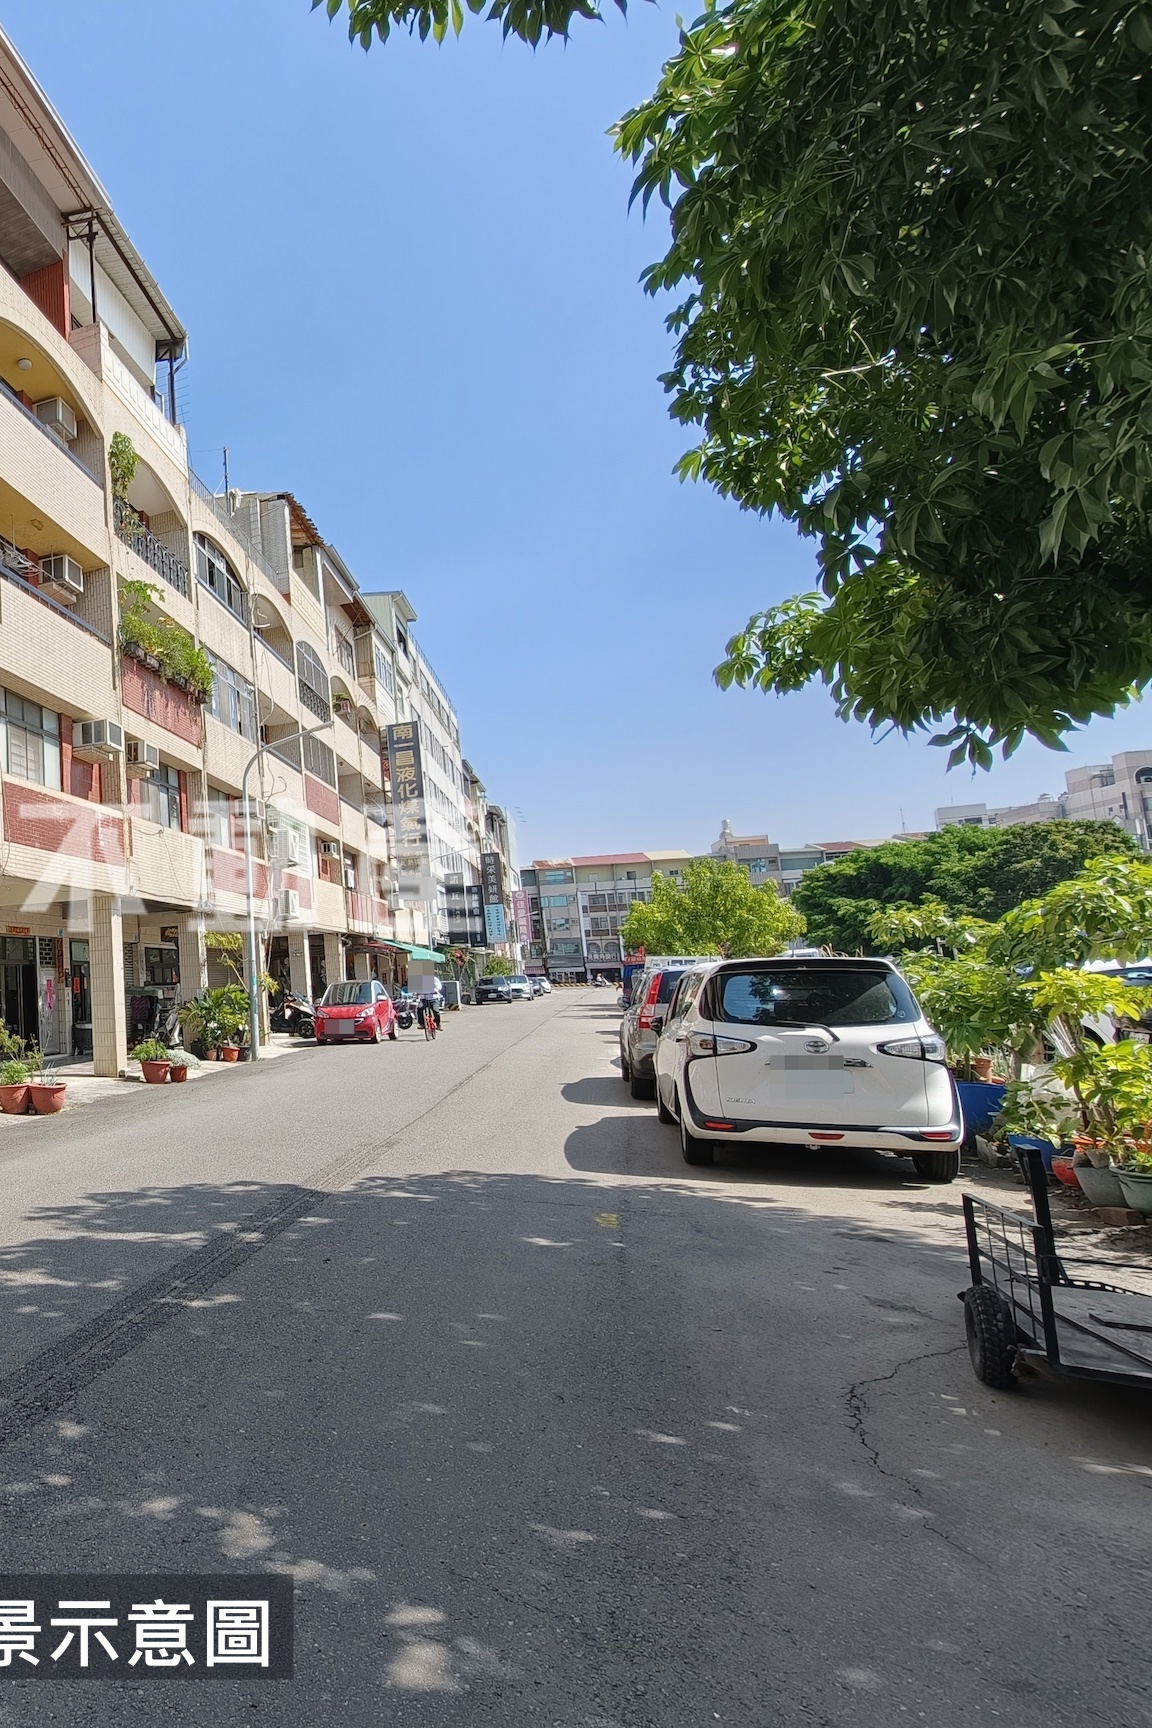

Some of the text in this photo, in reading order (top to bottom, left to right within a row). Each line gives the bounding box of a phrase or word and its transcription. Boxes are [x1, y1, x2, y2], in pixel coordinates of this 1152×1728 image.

[392, 725, 421, 848] 南一昌液化煤氣行
